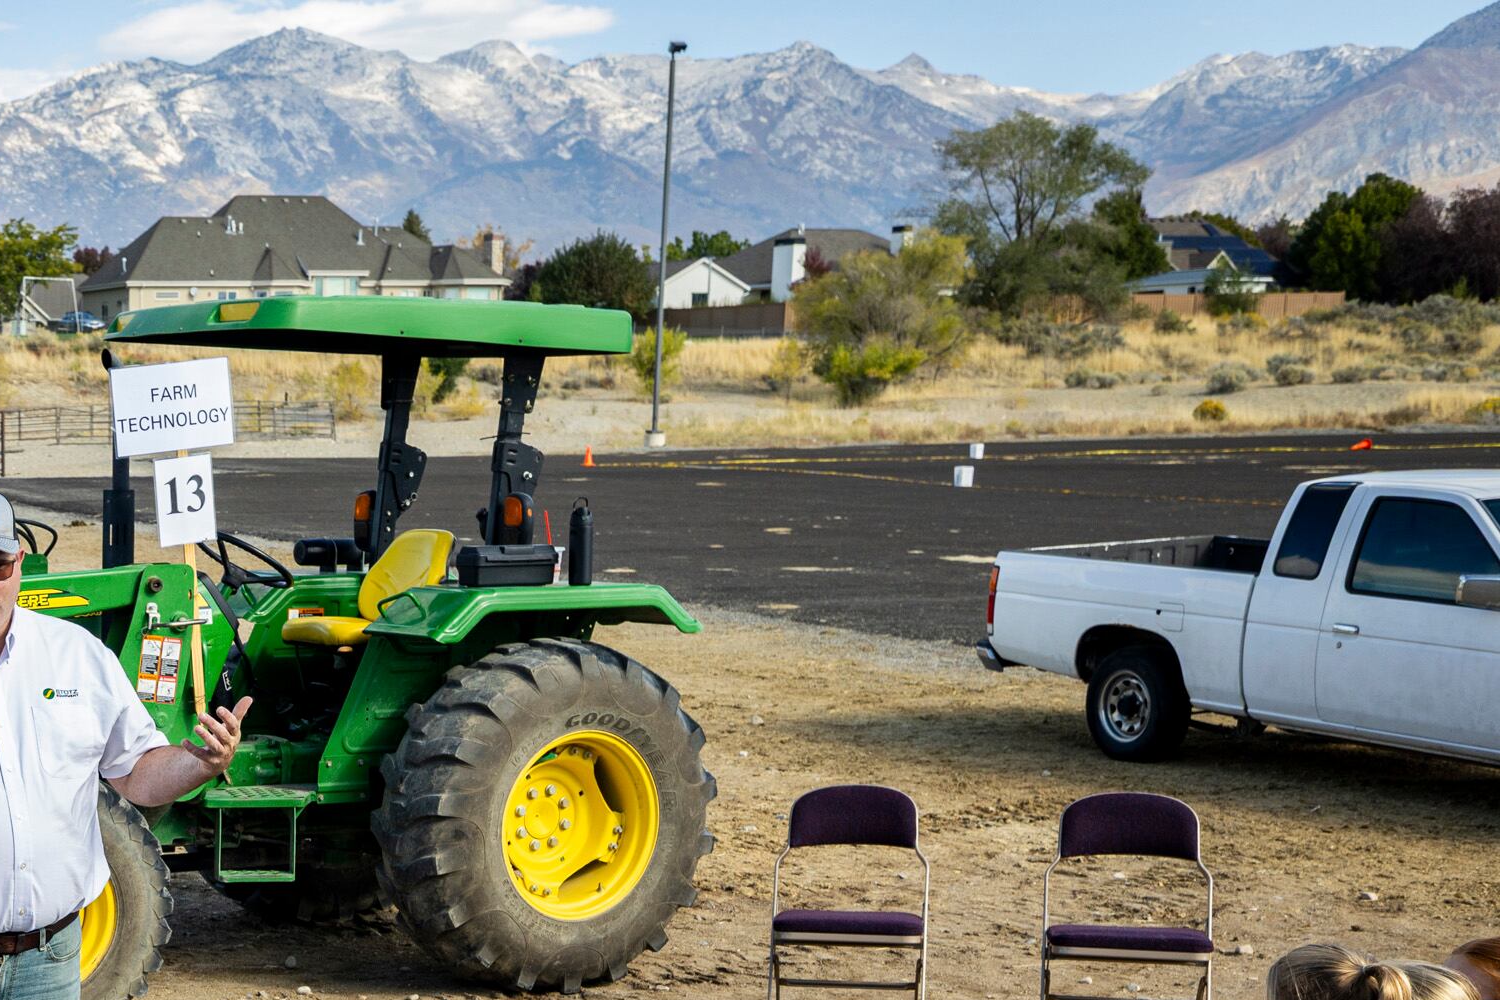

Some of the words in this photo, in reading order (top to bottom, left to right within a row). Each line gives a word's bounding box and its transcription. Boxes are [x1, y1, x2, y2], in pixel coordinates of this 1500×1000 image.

[150, 383, 198, 403] FARM
[117, 406, 230, 434] TECHNOLOGY
[164, 473, 207, 516] 13
[17, 593, 50, 609] ERE
[564, 712, 677, 812] GOODYEAR
